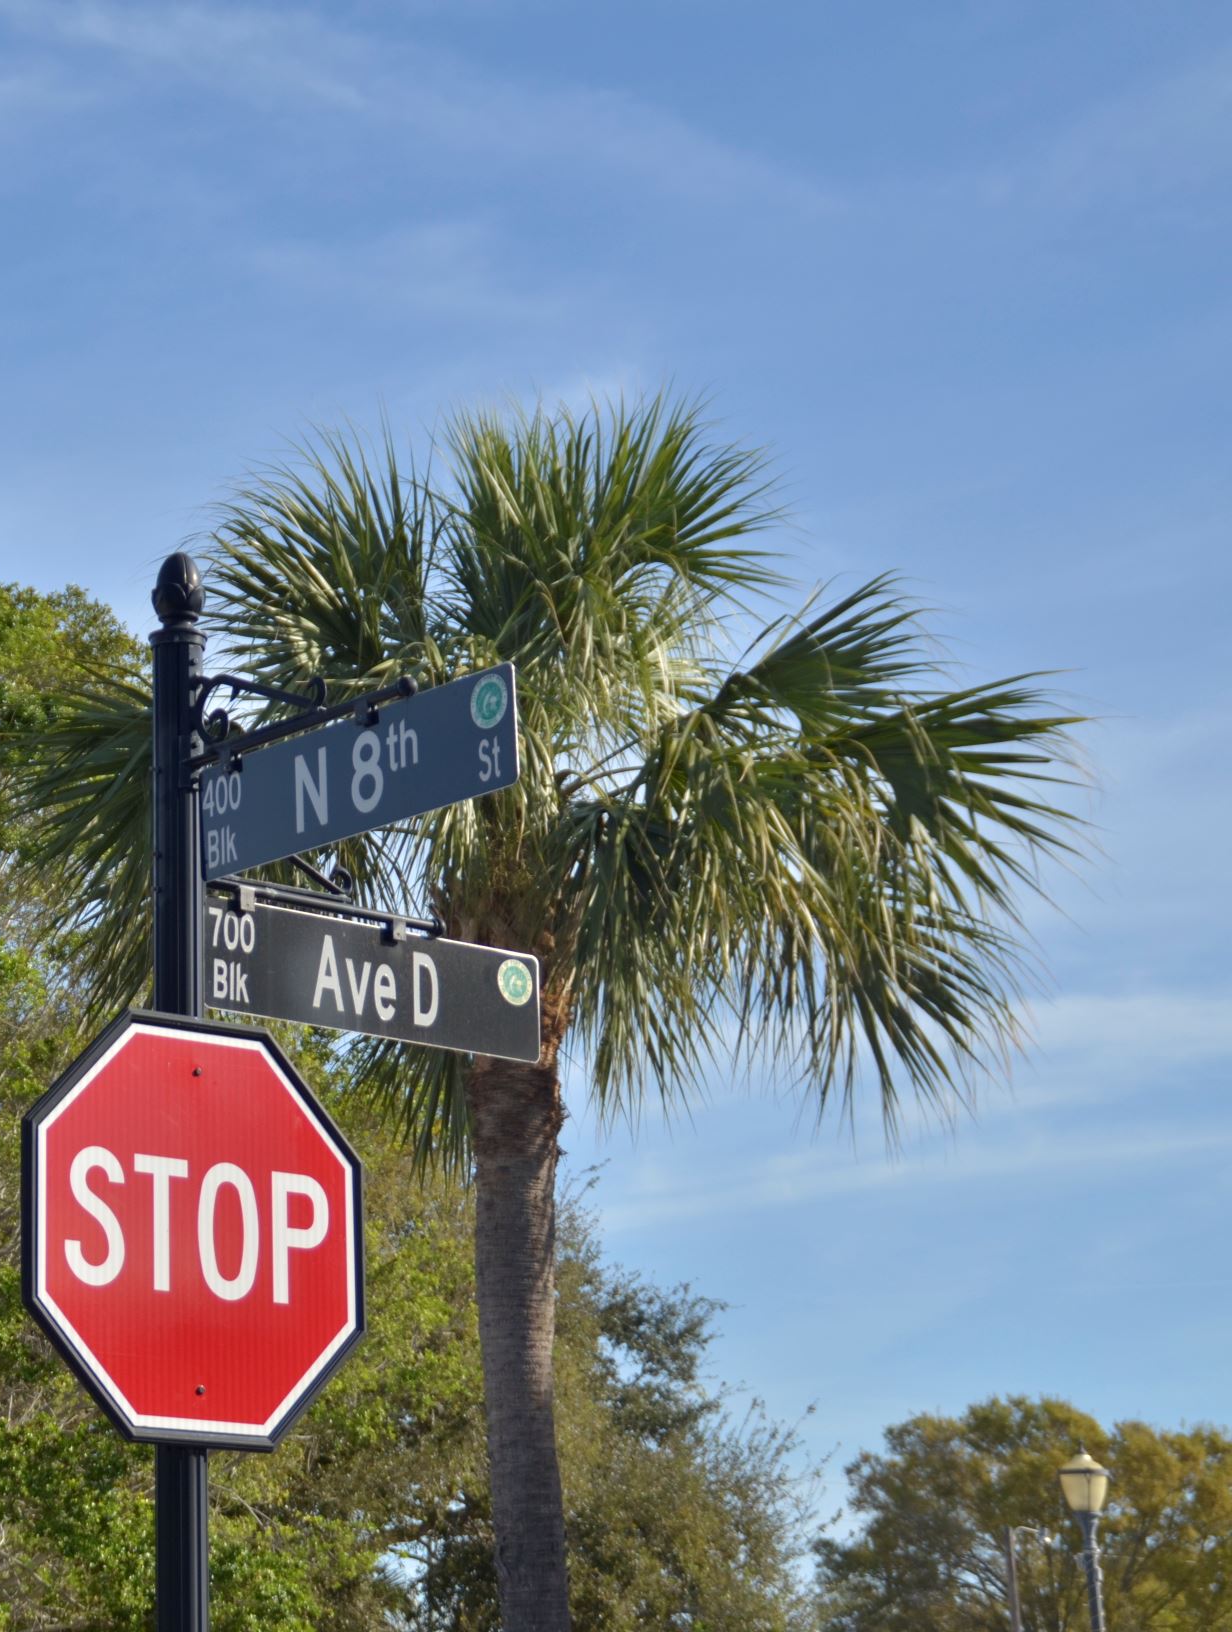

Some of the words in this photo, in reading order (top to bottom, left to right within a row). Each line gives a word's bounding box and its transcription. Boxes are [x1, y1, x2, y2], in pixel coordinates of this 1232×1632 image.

[202, 771, 241, 817] 400
[294, 746, 328, 834] N
[351, 719, 418, 813] 8th
[479, 736, 501, 782] St
[208, 824, 238, 869] Blk
[208, 906, 255, 953] 700
[213, 958, 249, 1003] Blk
[313, 935, 397, 1021] Ave
[413, 952, 439, 1027] D
[64, 1145, 329, 1304] STOP
